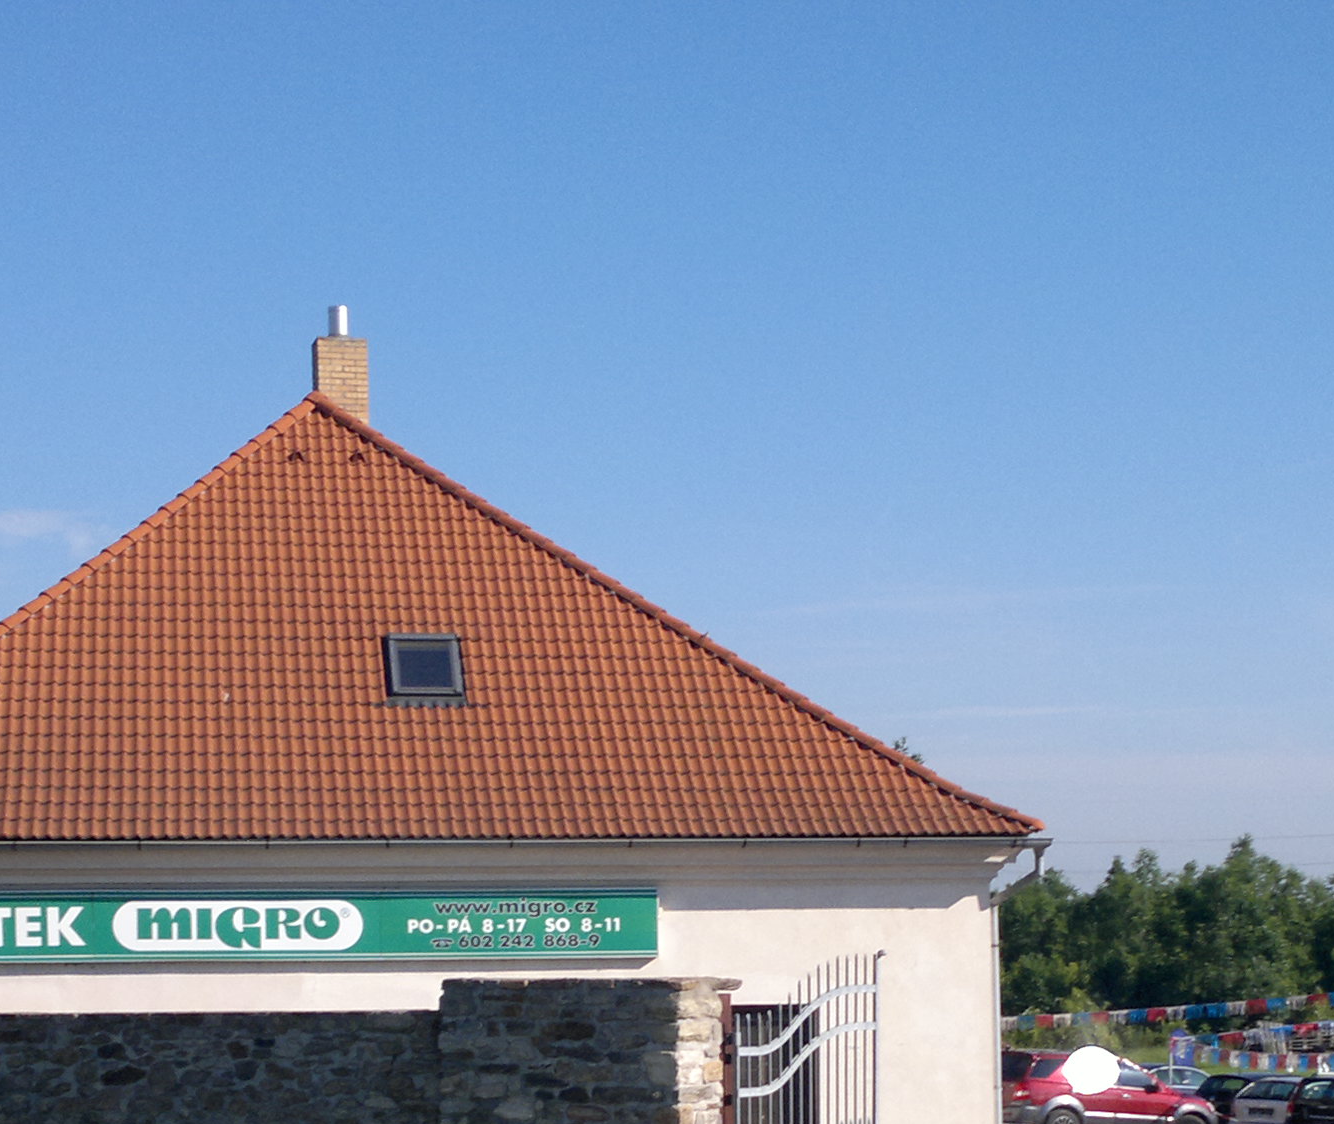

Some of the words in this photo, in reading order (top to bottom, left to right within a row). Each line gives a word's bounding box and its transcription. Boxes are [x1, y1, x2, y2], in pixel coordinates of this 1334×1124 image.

[434, 896, 598, 917] www.migro.cz
[482, 918, 528, 933] 8-17
[544, 917, 571, 932] SO
[580, 917, 621, 932] 8-11
[458, 935, 493, 948] 602
[500, 935, 534, 948] 242
[543, 934, 600, 948] 868-9
